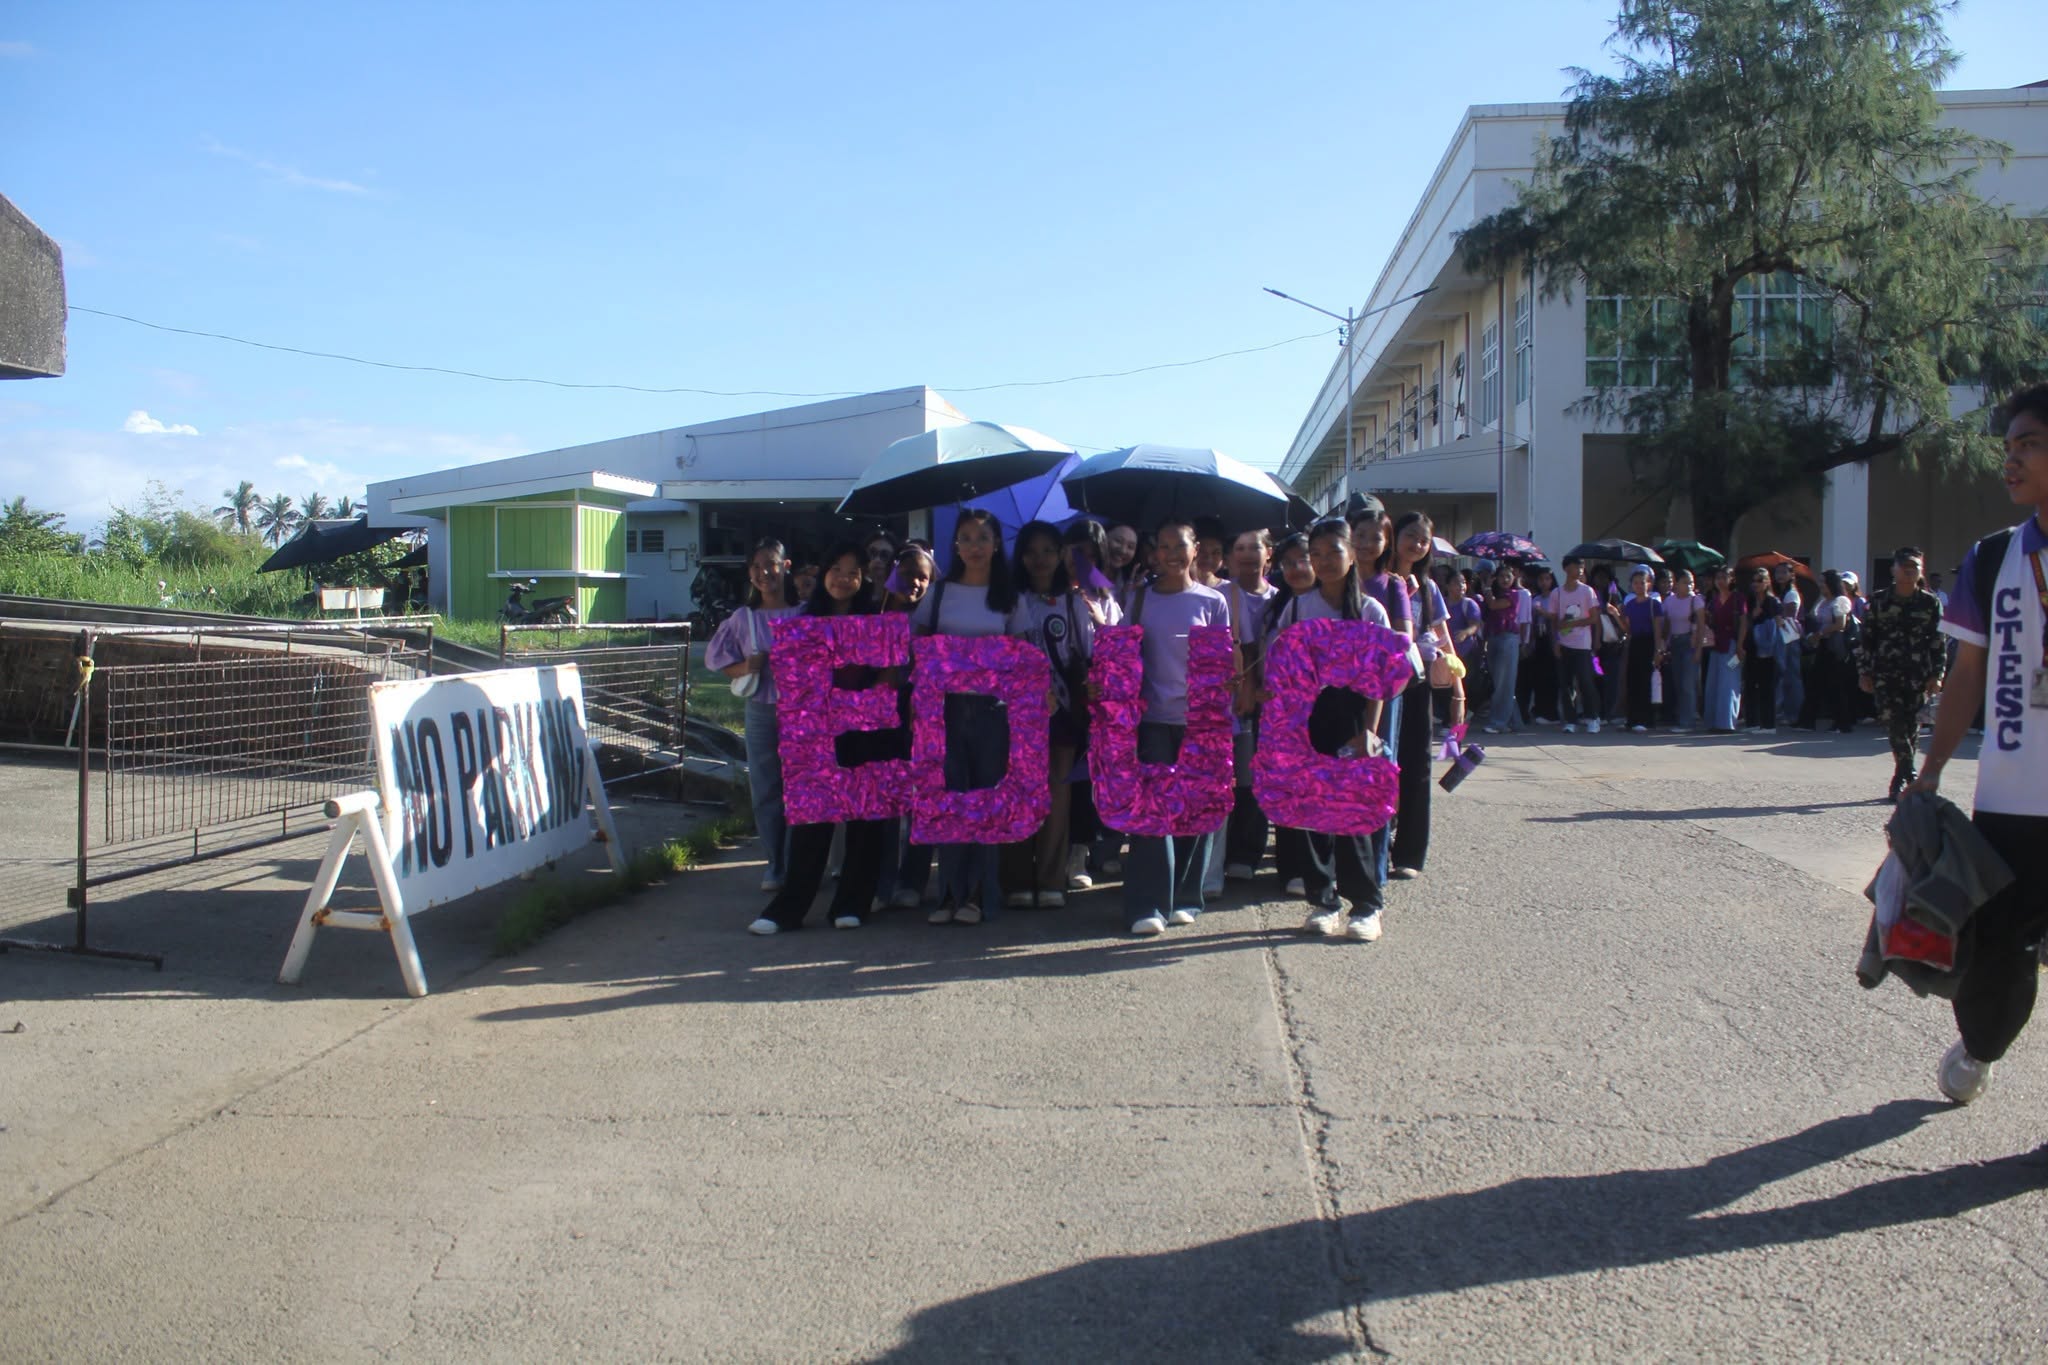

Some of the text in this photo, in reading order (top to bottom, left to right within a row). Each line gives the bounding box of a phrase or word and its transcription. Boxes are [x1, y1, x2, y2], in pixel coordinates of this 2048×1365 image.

[768, 612, 1412, 845] EDUC
[1995, 587, 2023, 751] CTESC
[389, 695, 585, 879] NO PARKING
